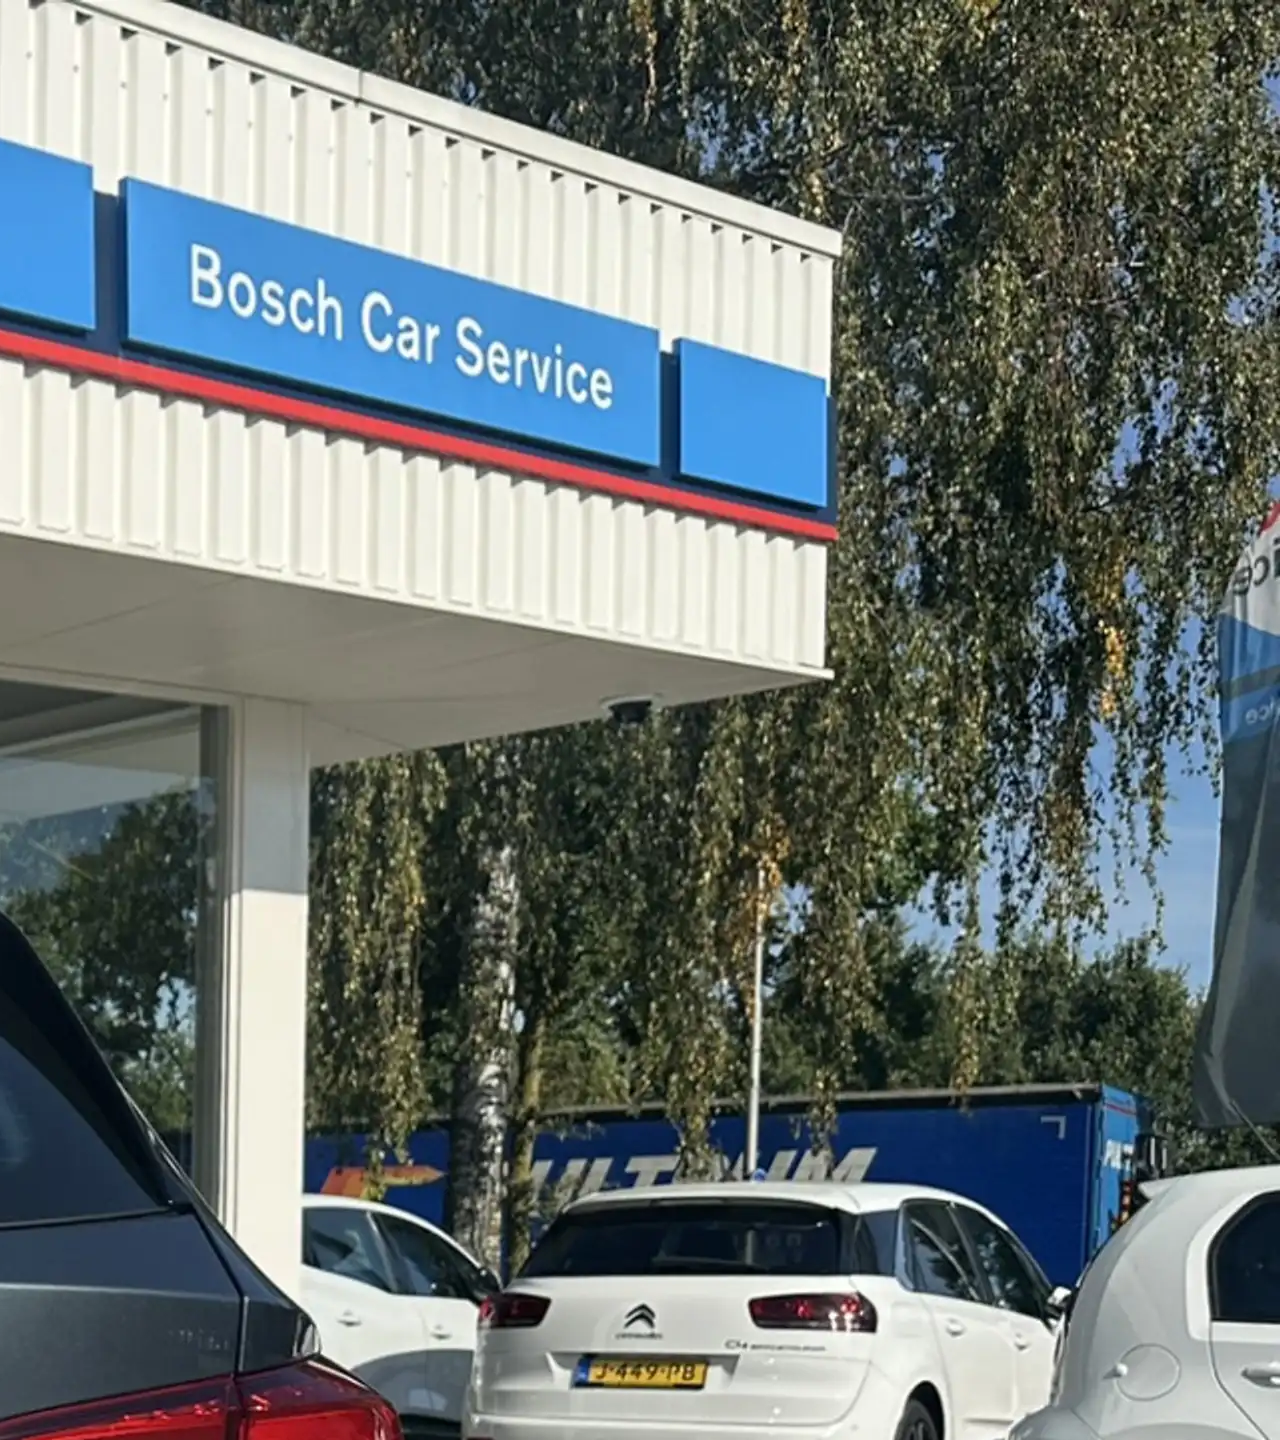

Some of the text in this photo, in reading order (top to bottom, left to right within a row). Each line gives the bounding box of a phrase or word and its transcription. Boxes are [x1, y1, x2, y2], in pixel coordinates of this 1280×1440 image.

[190, 242, 614, 410] Bosch Car Service
